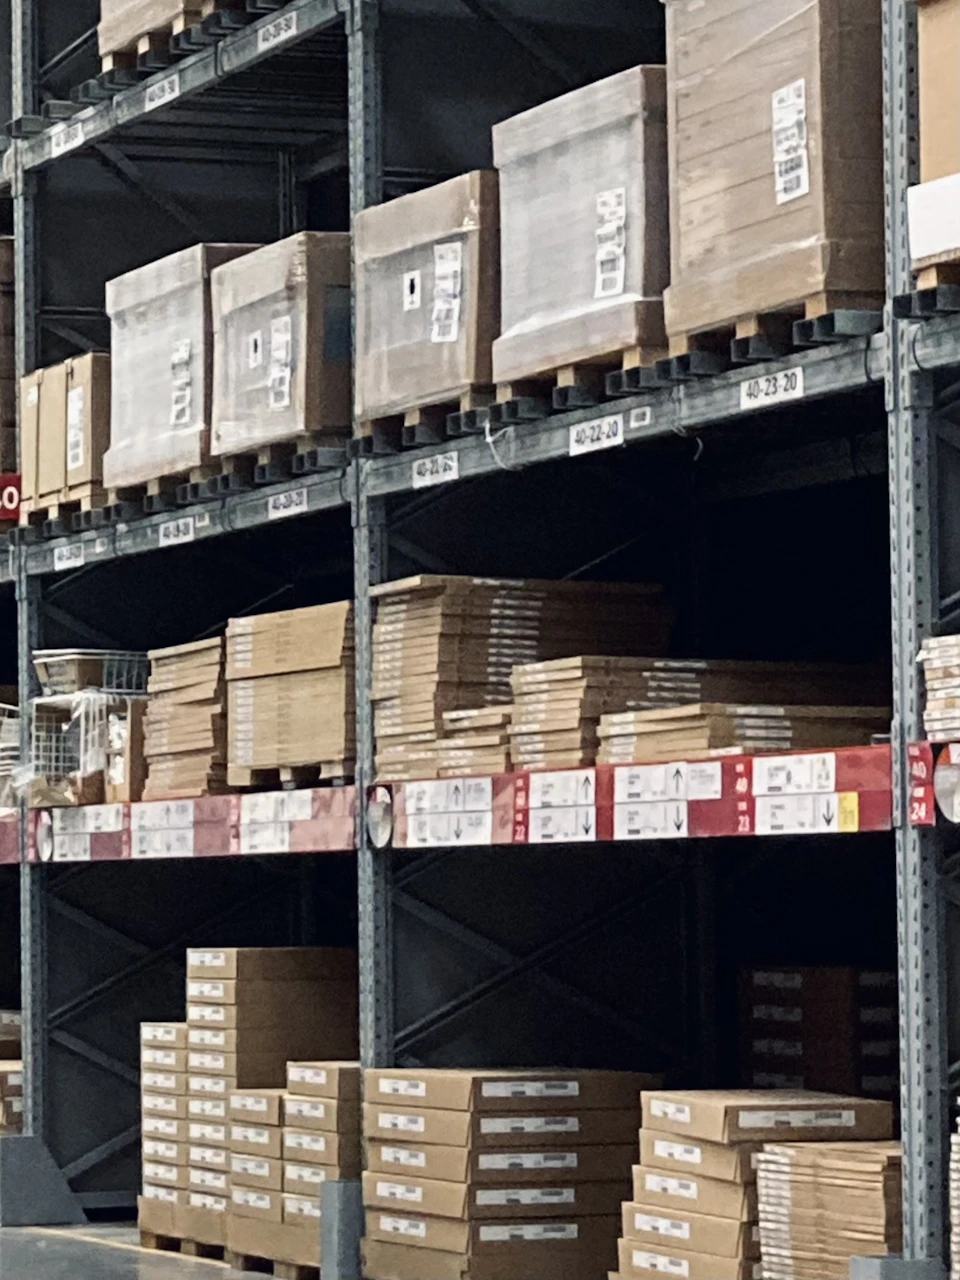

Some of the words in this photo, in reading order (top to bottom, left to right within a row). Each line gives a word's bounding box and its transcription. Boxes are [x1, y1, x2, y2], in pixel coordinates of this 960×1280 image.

[746, 371, 798, 400] 40-23-20
[574, 419, 618, 445] 40-22-20
[911, 801, 927, 821] 24
[738, 814, 751, 832] 23
